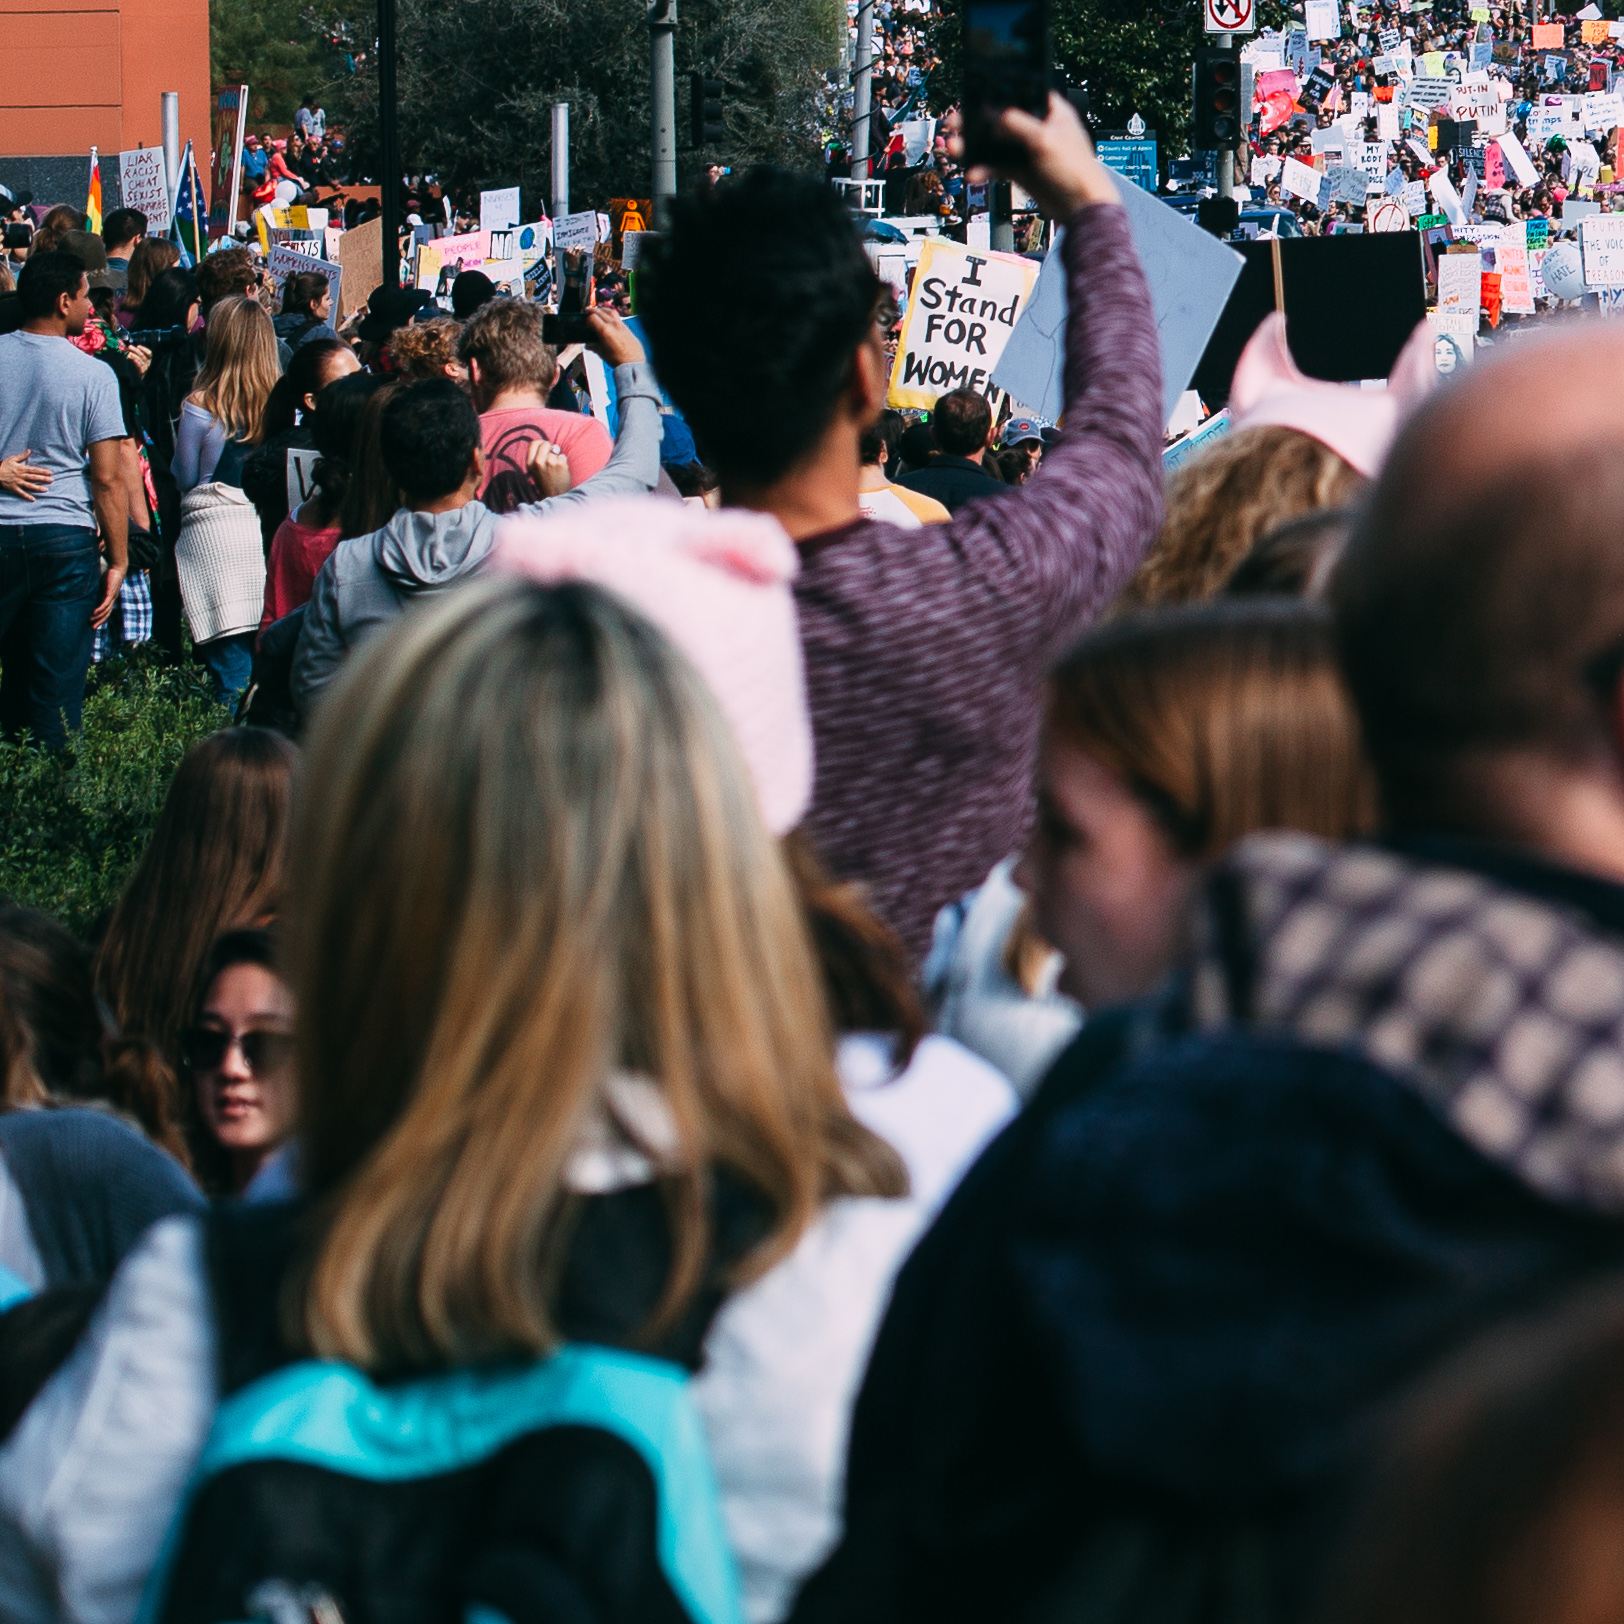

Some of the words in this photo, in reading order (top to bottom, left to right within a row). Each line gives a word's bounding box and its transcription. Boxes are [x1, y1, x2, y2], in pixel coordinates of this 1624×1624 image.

[1456, 84, 1488, 94] PUT-IN
[1456, 104, 1498, 120] PUTIN
[1367, 145, 1380, 153] MY
[128, 152, 153, 167] LIAR
[1361, 155, 1382, 163] BODY
[124, 164, 160, 179] RACIST
[129, 176, 157, 190] CHEAT
[125, 187, 162, 202] SEXIST
[1585, 221, 1624, 232] TRUMP
[444, 242, 481, 256] PEOPLE
[1585, 240, 1600, 251] THE
[1600, 255, 1609, 267] OF
[962, 255, 987, 287] I
[1551, 265, 1576, 285] HATE
[920, 278, 1019, 327] Stand
[925, 314, 987, 355] FOR
